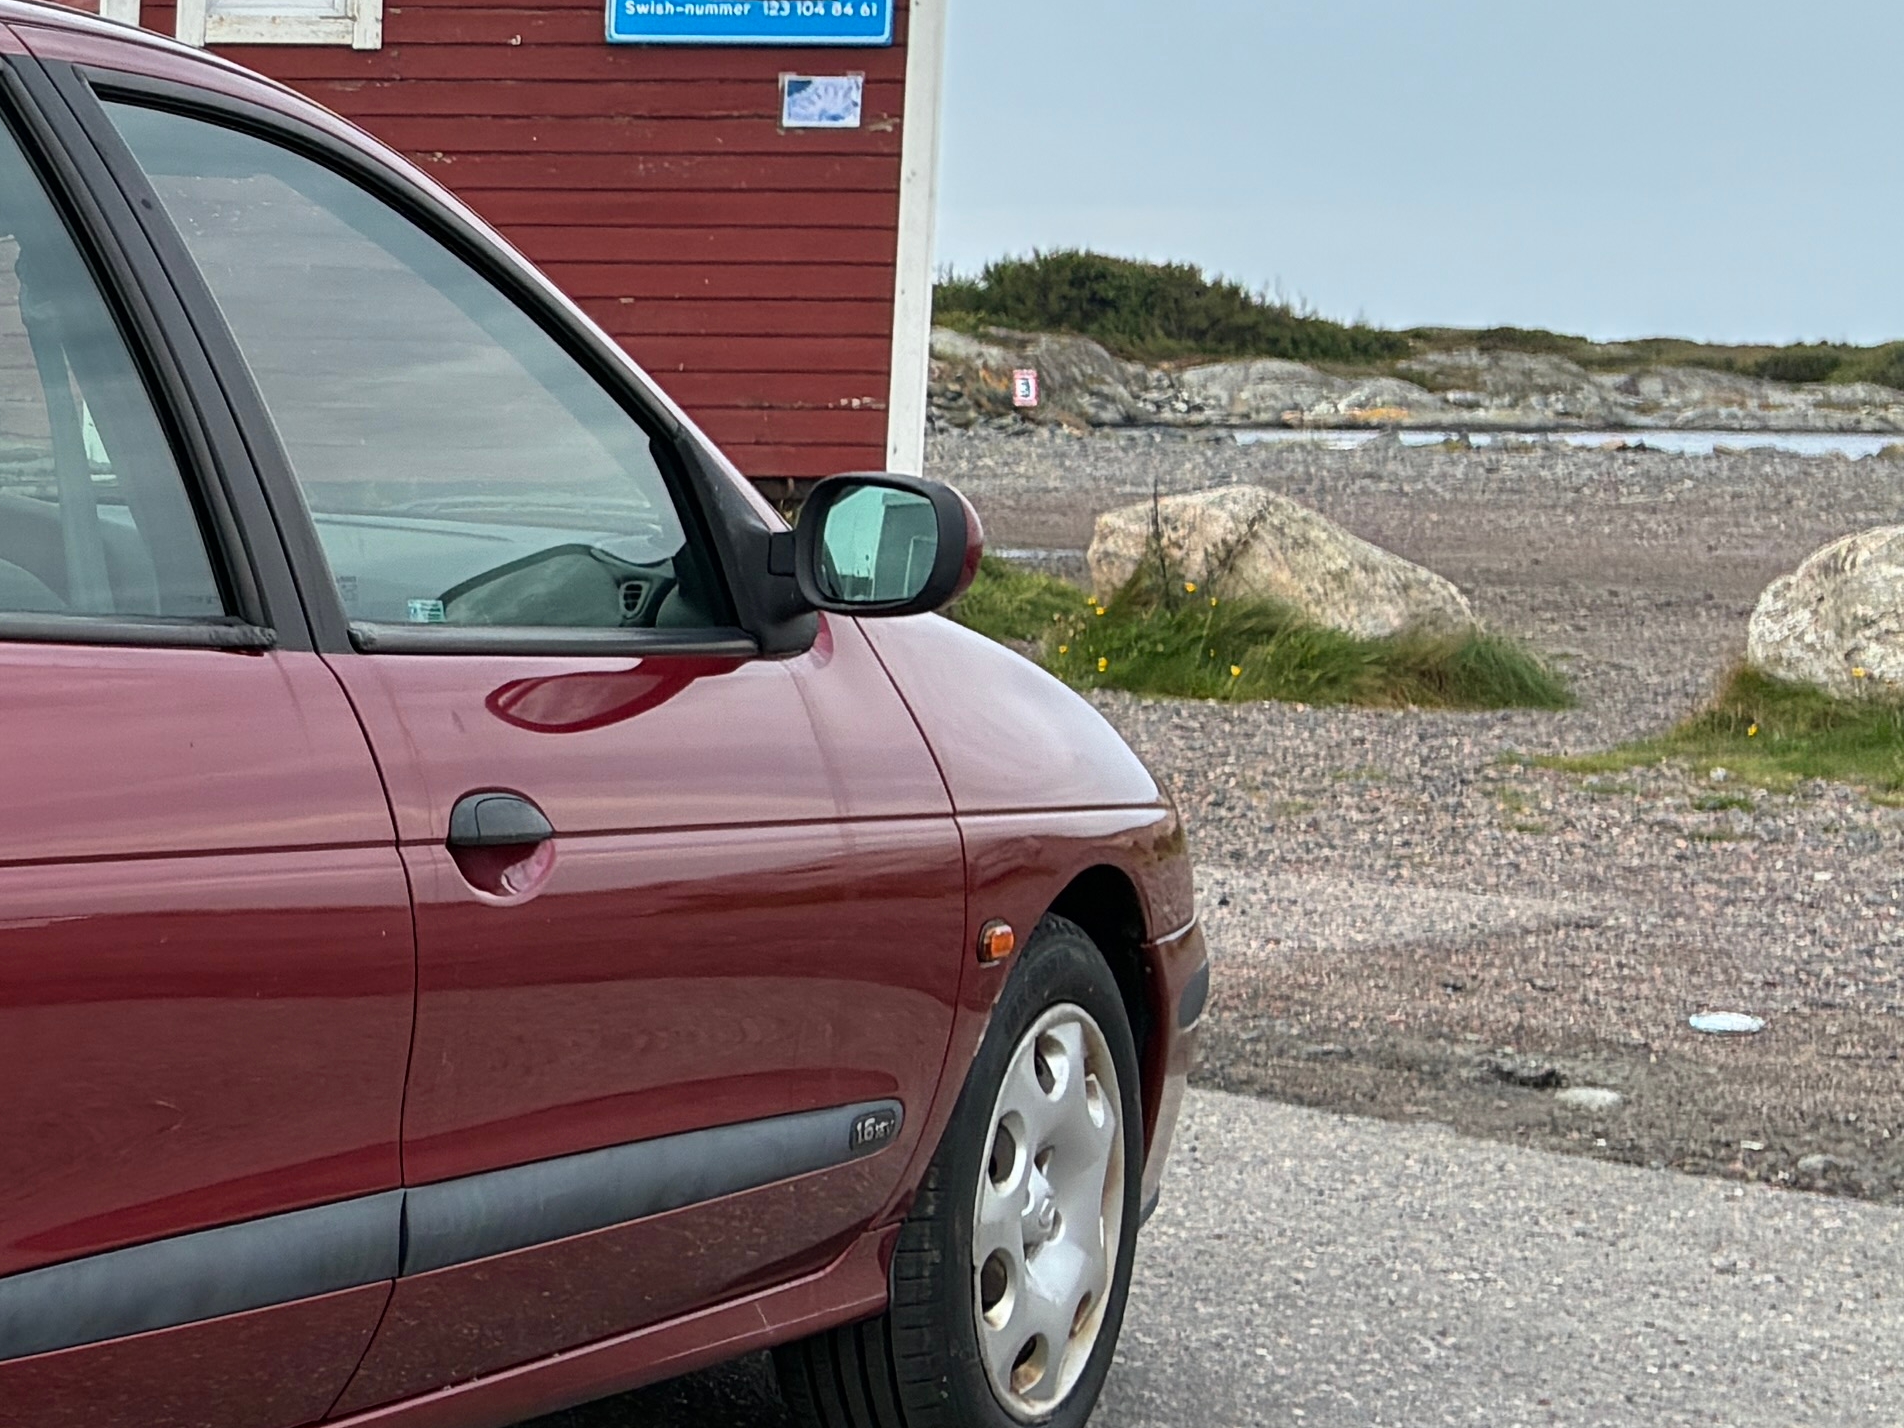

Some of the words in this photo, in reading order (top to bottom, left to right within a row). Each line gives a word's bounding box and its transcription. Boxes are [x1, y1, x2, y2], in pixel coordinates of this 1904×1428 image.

[625, 0, 752, 16] Swish-nummer
[763, 0, 790, 16] 123
[796, 1, 825, 16] 104
[860, 2, 877, 16] 61
